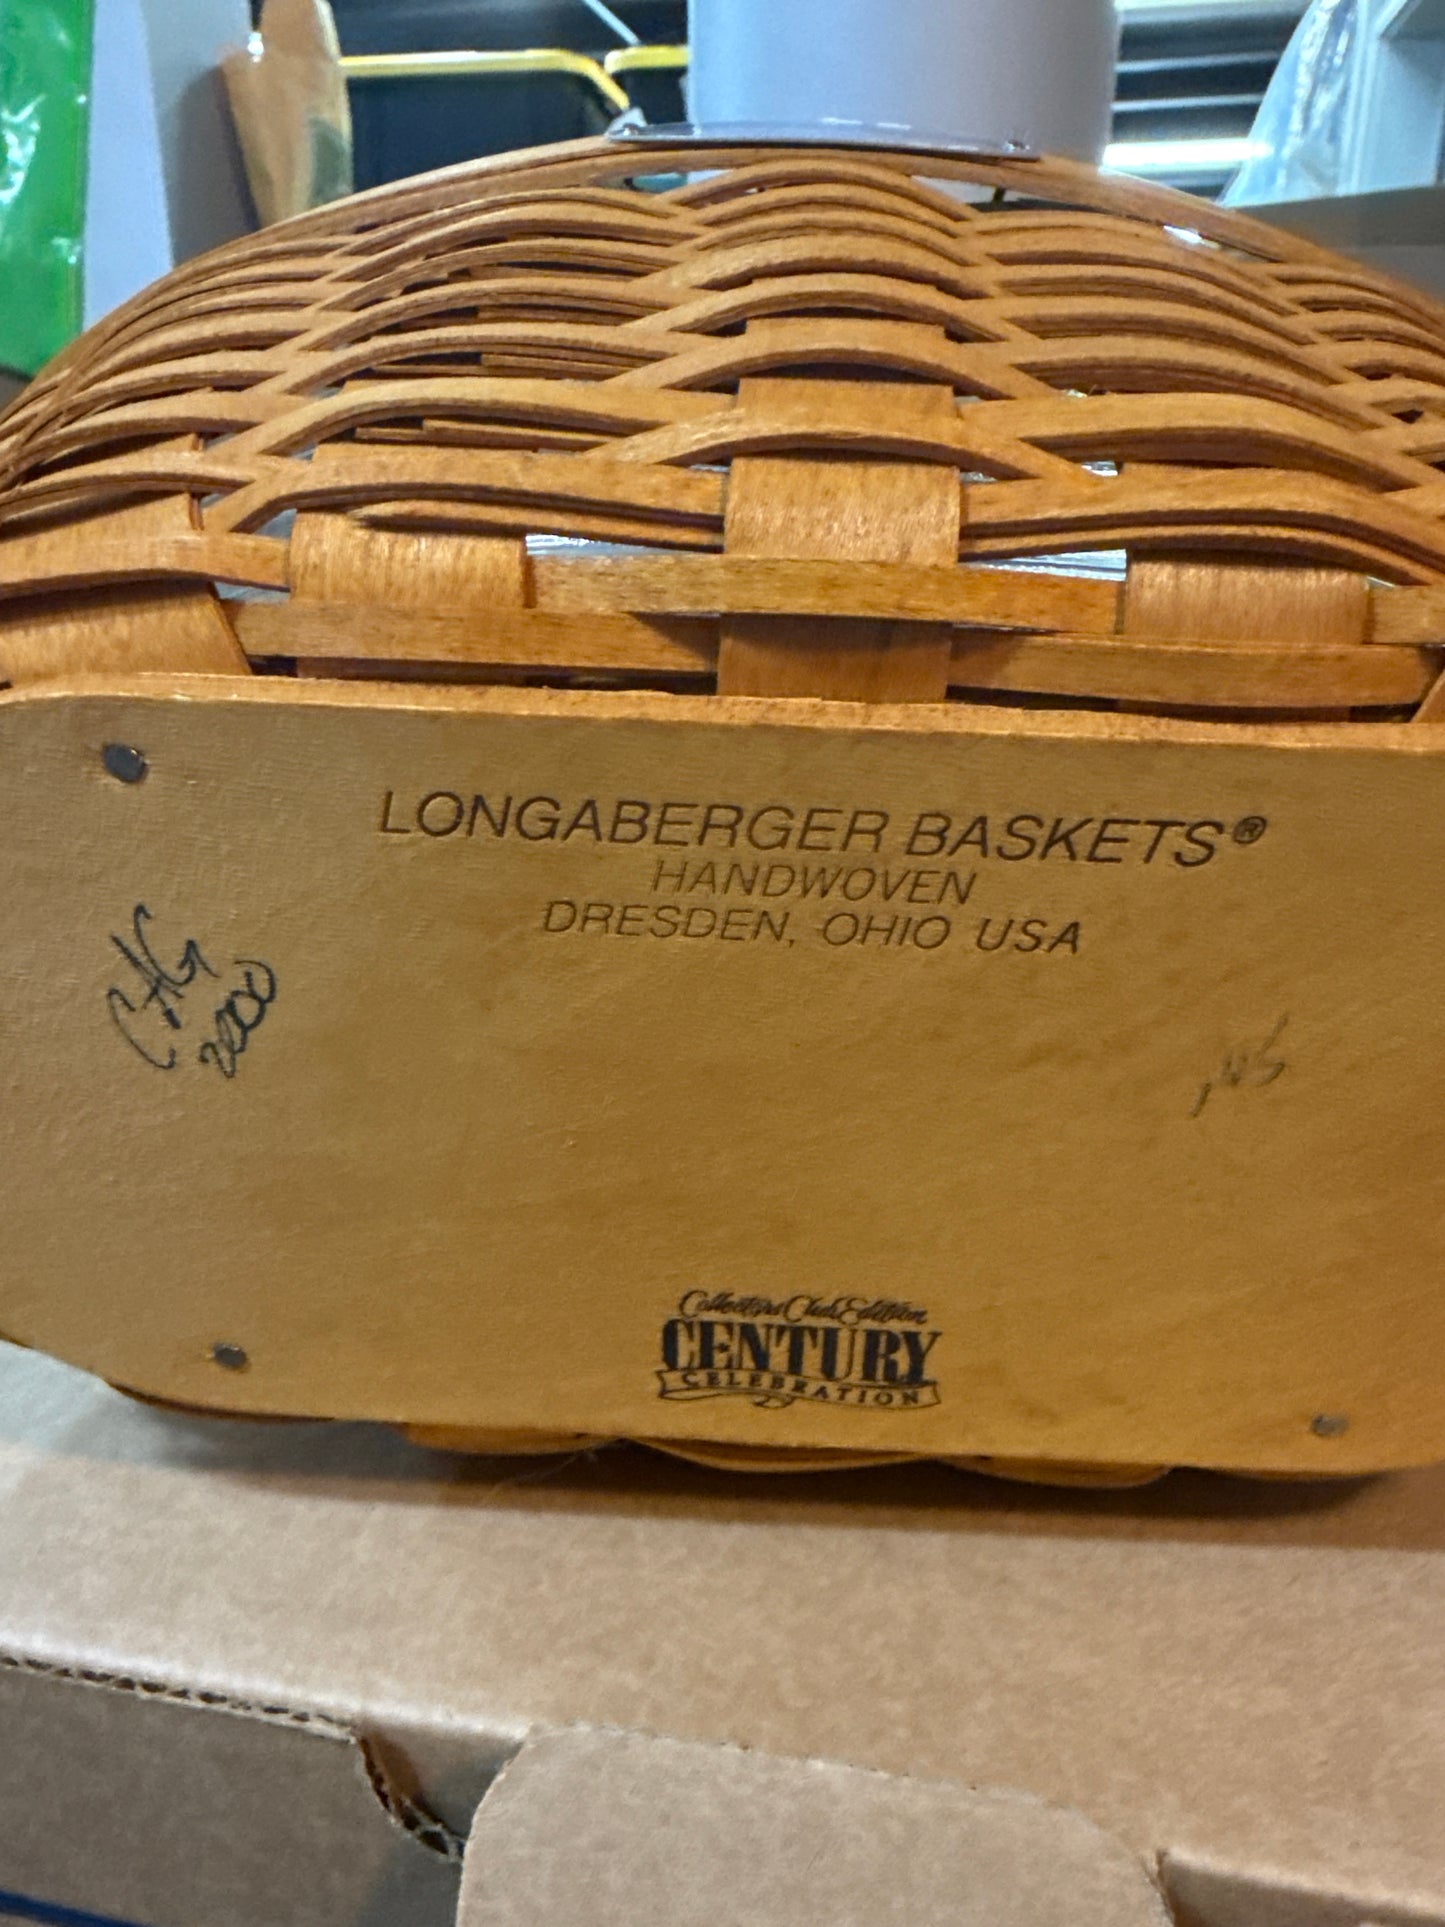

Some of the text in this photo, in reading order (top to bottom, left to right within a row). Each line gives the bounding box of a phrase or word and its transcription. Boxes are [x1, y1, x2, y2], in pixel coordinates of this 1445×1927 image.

[379, 790, 891, 851] LONGABERGER
[652, 859, 977, 905] HANDWOVEN
[543, 900, 1080, 955] DRESDEN, OHIO USA
[839, 1297, 928, 1325] Edition
[662, 1318, 943, 1386] CENTURY
[681, 1372, 921, 1406] CELEBRATION
